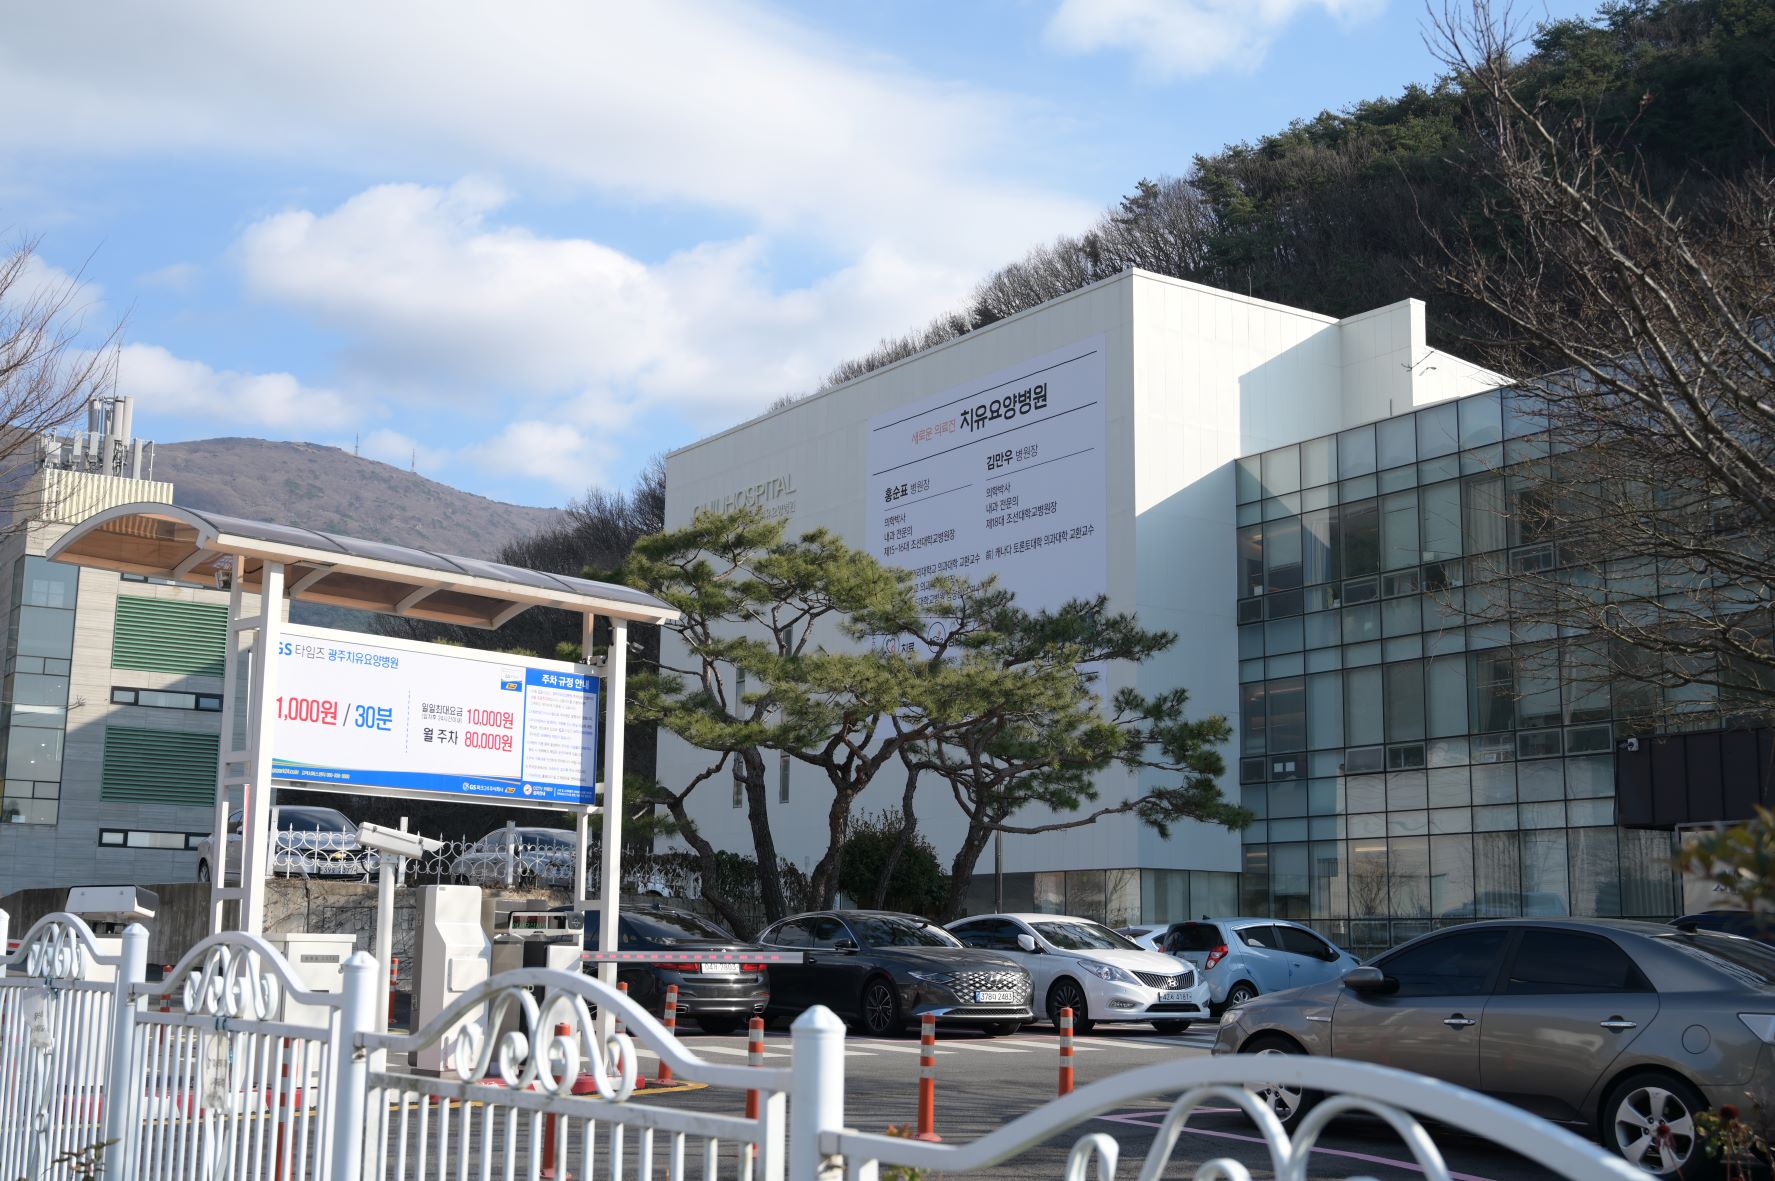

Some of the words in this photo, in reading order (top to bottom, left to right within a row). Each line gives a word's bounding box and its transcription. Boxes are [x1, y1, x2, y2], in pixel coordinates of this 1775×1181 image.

[911, 427, 933, 444] 새로운
[934, 419, 956, 436] 의료진
[960, 383, 1048, 432] 치유요양병원
[986, 449, 1014, 471] 김만우
[1015, 444, 1038, 462] 병원장
[884, 483, 909, 503] 홍순표
[910, 478, 930, 495] 병원장
[986, 482, 1011, 498] 의학박사
[985, 502, 998, 514] 내과
[999, 496, 1019, 511] 전문의
[985, 515, 1005, 529] 제18대
[1006, 500, 1058, 524] 조선대학교병원장
[884, 512, 906, 527] 의학박사
[896, 525, 913, 540] 전문의
[910, 529, 955, 549] 조선대학교병원장
[995, 544, 1012, 558] 캐나다
[1013, 537, 1043, 553] 토론토대학
[1044, 529, 1068, 545] 의과대학
[1069, 524, 1095, 540] 교환교수
[295, 644, 325, 660] 타임즈
[328, 648, 399, 669] 광주치유요양병원
[541, 674, 558, 685] 주차
[558, 676, 574, 688] 규정
[574, 678, 590, 690] 안내
[276, 696, 337, 726] 1,000원
[355, 705, 393, 731] 30분
[421, 702, 463, 717] 일일최대요금
[467, 708, 514, 730] 10,000원
[423, 727, 434, 743] 월
[437, 729, 459, 745] 주차
[464, 731, 513, 752] 80,000원
[998, 992, 1013, 1001] 2483
